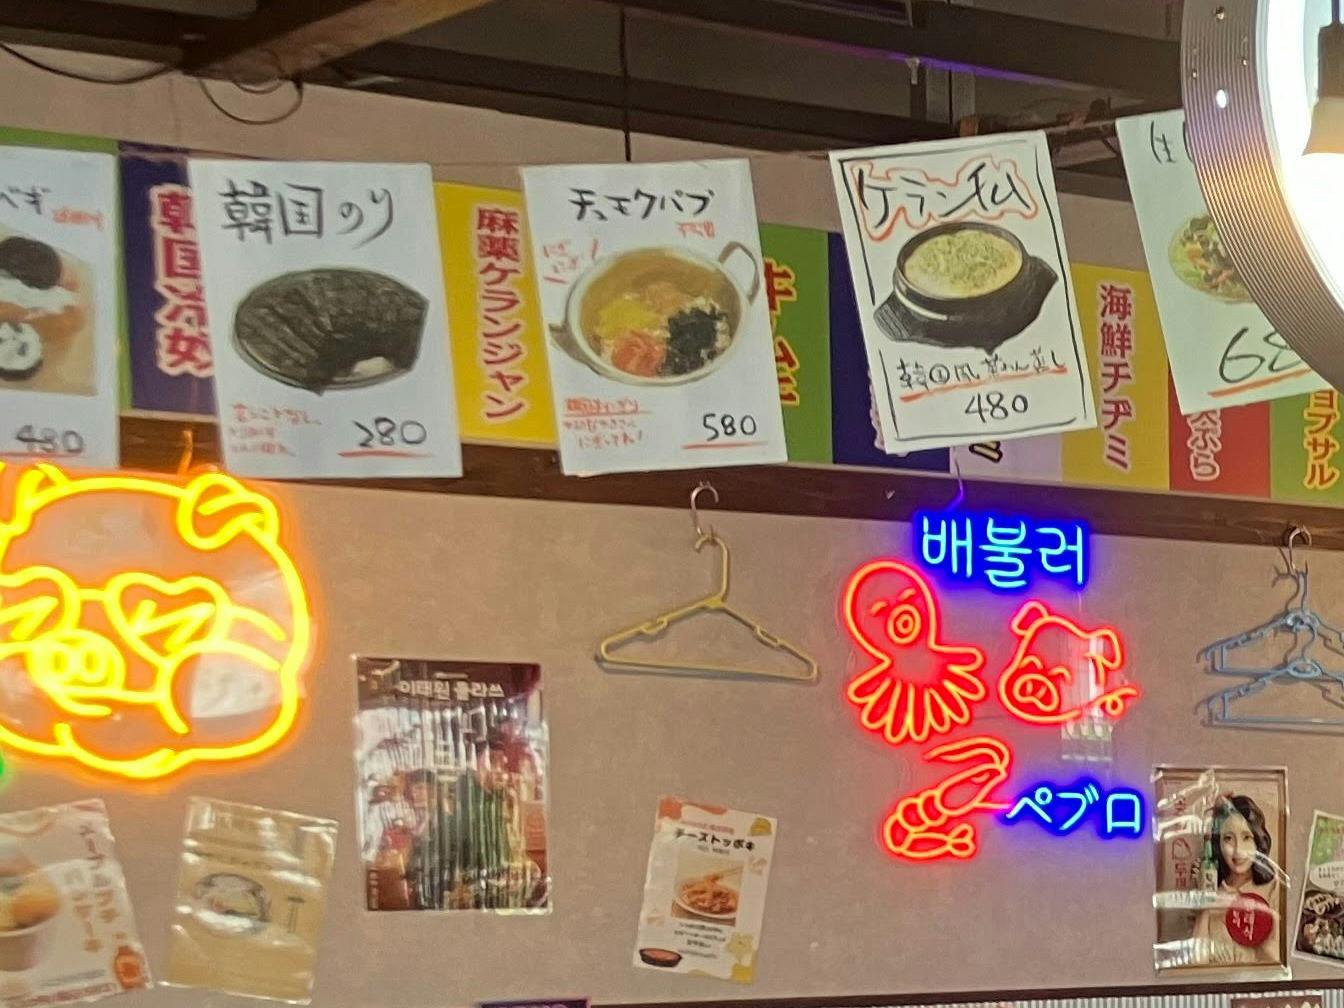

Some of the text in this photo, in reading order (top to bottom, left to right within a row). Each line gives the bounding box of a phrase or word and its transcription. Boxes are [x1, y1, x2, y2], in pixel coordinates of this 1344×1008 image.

[221, 178, 394, 249] 韓国のり
[476, 206, 522, 420] 麻薬ケランジャン
[1099, 284, 1135, 470] 海鮮チヂミ
[1218, 326, 1306, 384] 68
[354, 418, 429, 449] 280
[702, 413, 758, 441] 580
[964, 391, 1029, 424] 480
[921, 515, 1085, 589] 배불러
[1005, 783, 1142, 834] ペブロ
